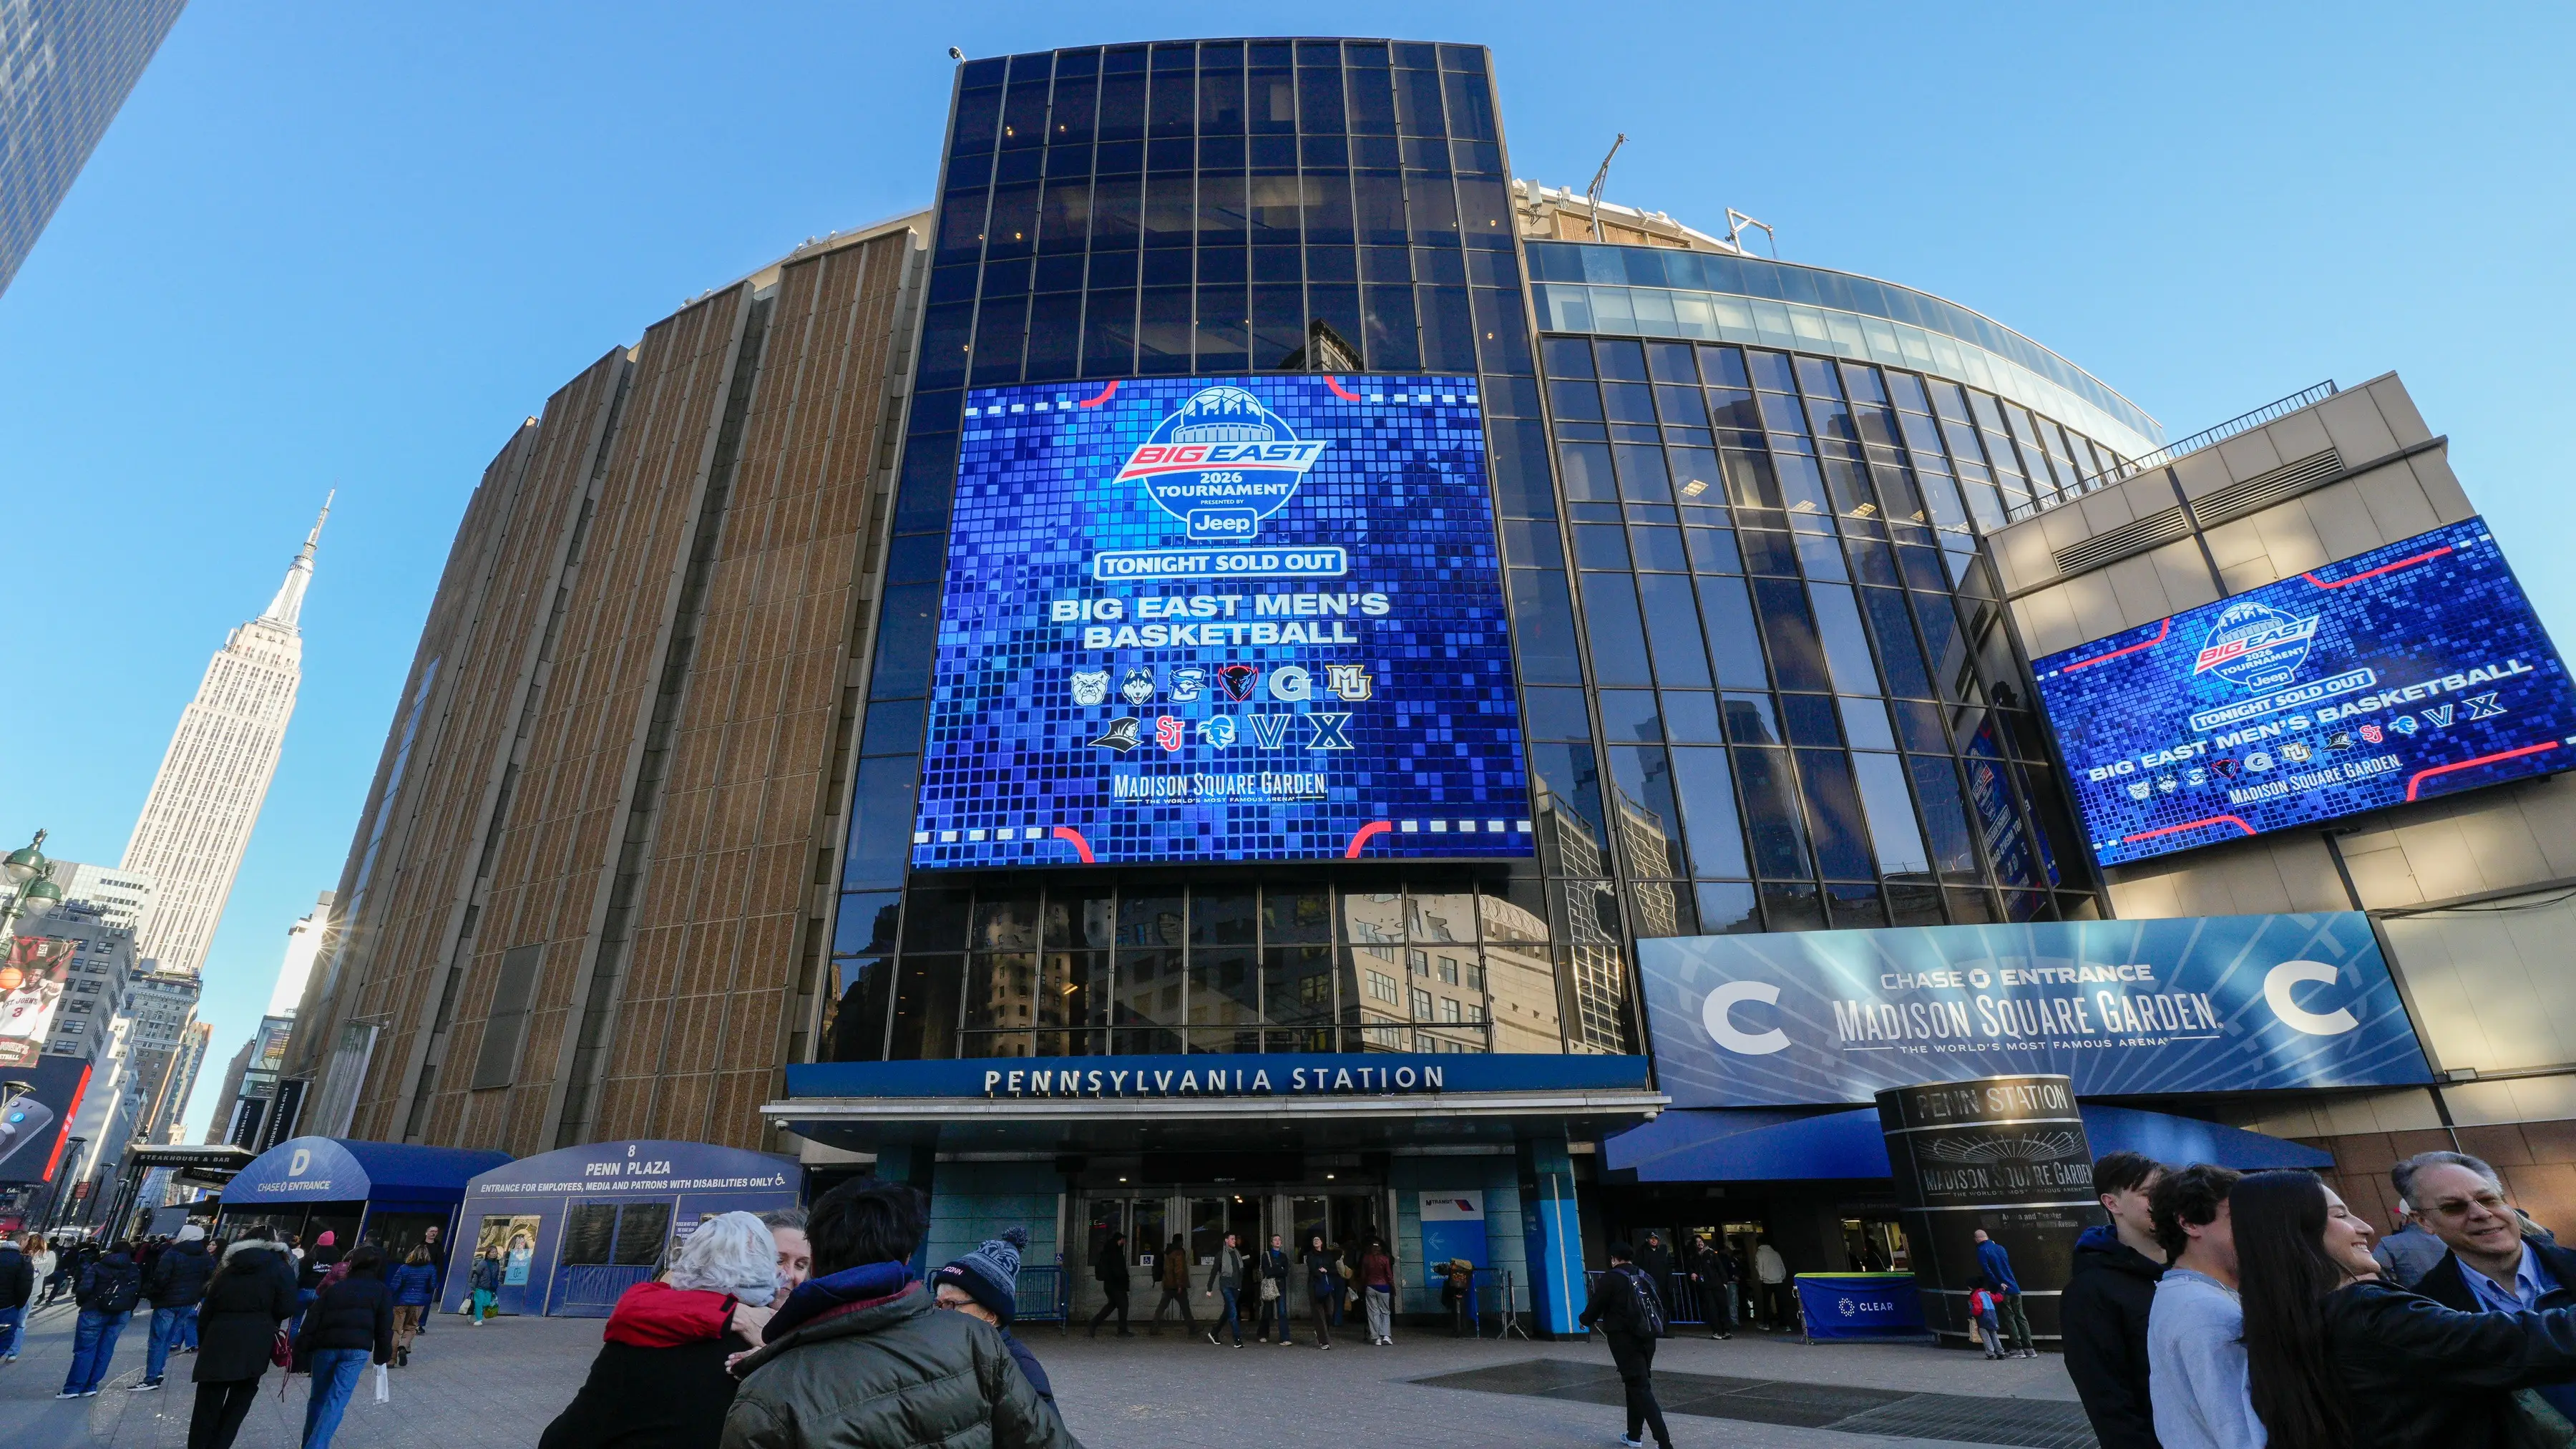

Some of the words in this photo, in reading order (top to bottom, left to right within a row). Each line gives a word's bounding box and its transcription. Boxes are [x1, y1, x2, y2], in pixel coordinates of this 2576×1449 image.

[1131, 446, 1209, 464] BIG
[1206, 444, 1317, 462] EAST
[1156, 483, 1289, 497] TOURNAMENT
[1200, 472, 1242, 484] 2026
[1195, 514, 1250, 533] Jeep
[1103, 555, 1210, 575] TONIGHT
[1215, 554, 1279, 572] SOLD
[1287, 553, 1336, 570] OUT
[1051, 597, 1123, 622] BIG
[1137, 595, 1242, 618] EAST
[1255, 592, 1390, 616] MEN'S
[1083, 621, 1357, 648] BASKETBALL
[2199, 640, 2244, 663] BIG
[2249, 620, 2314, 646] EAST
[2220, 646, 2306, 676] TOURNAMENT
[2244, 648, 2273, 663] 2026
[2253, 671, 2290, 687] Jeep
[2197, 698, 2273, 724] TONIGHT
[2275, 685, 2324, 707] SOLD
[2326, 673, 2365, 693] OUT
[2089, 761, 2136, 782] BIG
[2140, 740, 2208, 769] EAST
[2215, 715, 2311, 750] MEN'S
[2316, 658, 2534, 723] BASKETBALL
[1113, 773, 1188, 798] MADISON
[1194, 772, 1256, 797] SQUARE
[2229, 779, 2289, 805] MADISON
[2290, 767, 2343, 791] SQUARE
[1880, 969, 1966, 990] CHASE
[2001, 964, 2155, 987] ENTRANCE
[2264, 960, 2359, 1035] C
[11, 1007, 24, 1018] 3
[1702, 980, 1791, 1055] C
[1833, 1000, 1973, 1042] MADISON
[1976, 994, 2095, 1040] SQUARE
[2097, 990, 2218, 1034] GARDEN
[1899, 1045, 1928, 1055] THE
[1933, 1043, 2001, 1053] WORLD'S
[2006, 1040, 2049, 1051] MOST
[2053, 1038, 2113, 1050] FAMOUS
[2119, 1038, 2165, 1047] ARENA
[985, 1069, 1272, 1093] PENNSYLVANIA
[1292, 1066, 1444, 1091] STATION
[1916, 1089, 1981, 1118] PENN
[1986, 1085, 2069, 1112] STATION
[235, 1128, 245, 1146] STEAK
[267, 1113, 283, 1149] STEAKHOUSE
[288, 1148, 311, 1176] D
[628, 1145, 635, 1157] 8
[585, 1162, 621, 1176] PENN
[627, 1161, 670, 1174] PLAZA
[2054, 1161, 2093, 1186] GARDEN
[258, 1181, 280, 1192] CHASE
[288, 1181, 331, 1191] ENTRANCE
[481, 1184, 520, 1193] ENTRANCE
[520, 1183, 537, 1192] FOR
[537, 1182, 584, 1193] EMPLOYEES,
[585, 1181, 610, 1191] MEDIA
[612, 1181, 630, 1190] AND
[631, 1180, 668, 1190] PATRONS
[670, 1179, 691, 1189] WITH
[693, 1178, 748, 1189] DISABILITIES
[750, 1177, 774, 1187] ONLY
[1860, 1302, 1893, 1311] CLEAR
